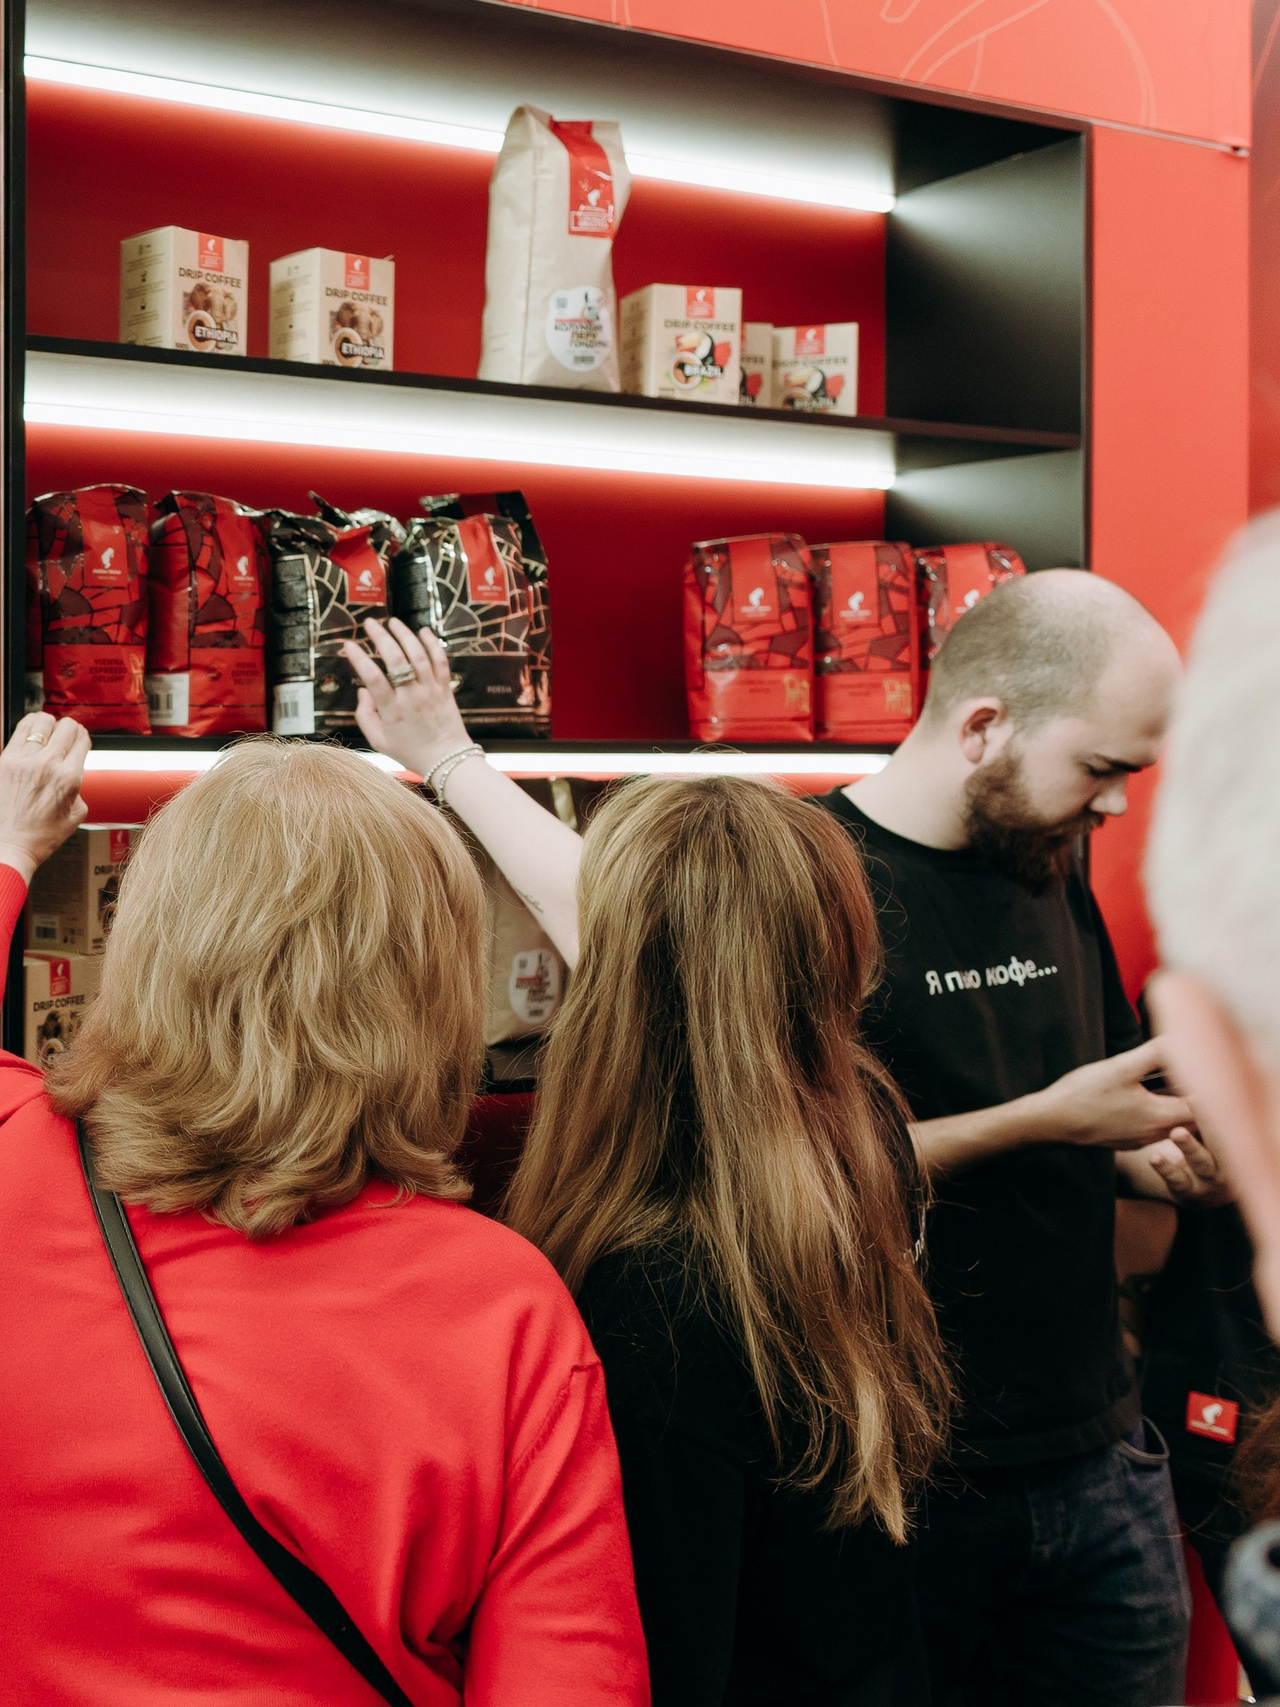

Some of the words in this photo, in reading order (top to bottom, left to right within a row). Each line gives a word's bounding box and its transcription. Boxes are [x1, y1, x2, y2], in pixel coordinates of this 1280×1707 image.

[178, 267, 203, 281] DRIP
[205, 272, 242, 289] COFFEE
[325, 287, 350, 299] DRIP
[352, 291, 389, 306] COFFEE
[195, 325, 239, 344] ETHIOPIA
[664, 320, 691, 330] DRIP
[694, 321, 736, 332] COFFEE
[341, 342, 385, 360] ETHIOPIA
[925, 970, 943, 996] Я
[33, 1000, 54, 1012] DRIP
[55, 994, 85, 1008] COFFEE
